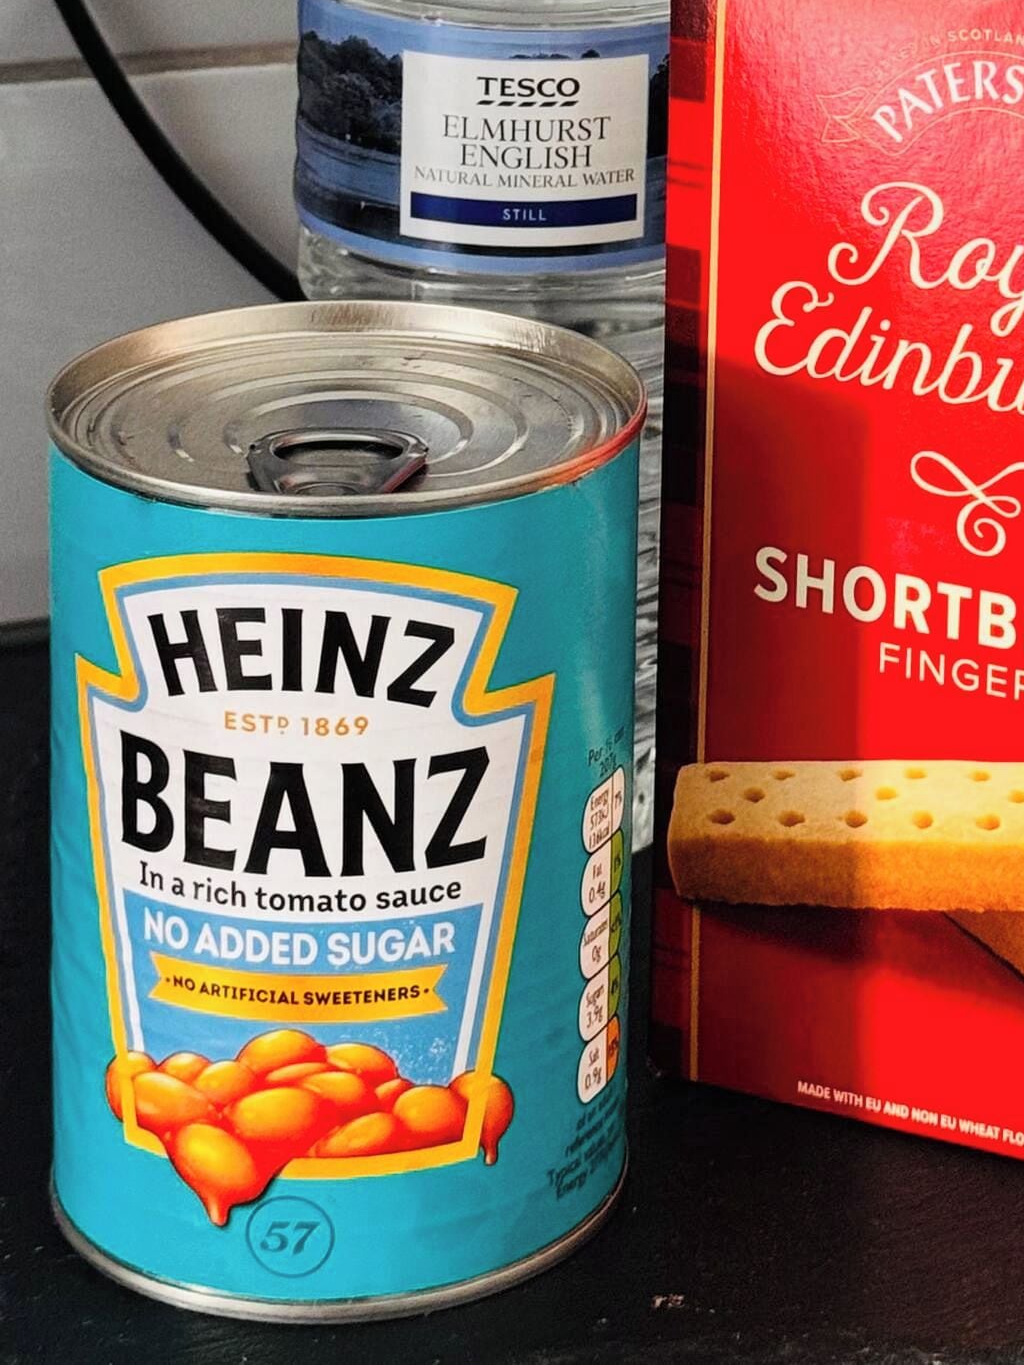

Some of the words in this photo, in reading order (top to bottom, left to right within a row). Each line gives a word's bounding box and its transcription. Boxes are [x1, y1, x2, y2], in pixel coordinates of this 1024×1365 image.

[477, 76, 580, 98] TESCO
[442, 114, 612, 142] ELMHURST
[460, 144, 592, 169] ENGLISH
[414, 165, 492, 186] NATURAL
[498, 174, 578, 189] MINERAL
[582, 168, 635, 185] WATER
[503, 208, 547, 221] STILL
[147, 607, 455, 708] HEINZ
[301, 714, 369, 737] 1869
[119, 728, 490, 877] BEANZ
[139, 860, 164, 891] In
[171, 877, 185, 896] a
[193, 877, 246, 908] rich
[255, 887, 367, 912] tomato
[376, 881, 462, 909] sauce
[144, 906, 190, 950] NO
[194, 923, 319, 966] ADDED
[327, 922, 456, 966] SUGAR
[173, 975, 196, 991] NO
[199, 982, 300, 1005] ARTIFICIAL
[303, 985, 421, 1005] SWEETENERS
[797, 1080, 832, 1100] MADE
[833, 1088, 864, 1108] WITH
[865, 1096, 882, 1113] EU
[883, 1101, 910, 1119] AND
[911, 1107, 938, 1126] NON
[940, 1114, 957, 1130] EU
[959, 1118, 1001, 1141] WHEAT
[260, 1220, 320, 1255] 57
